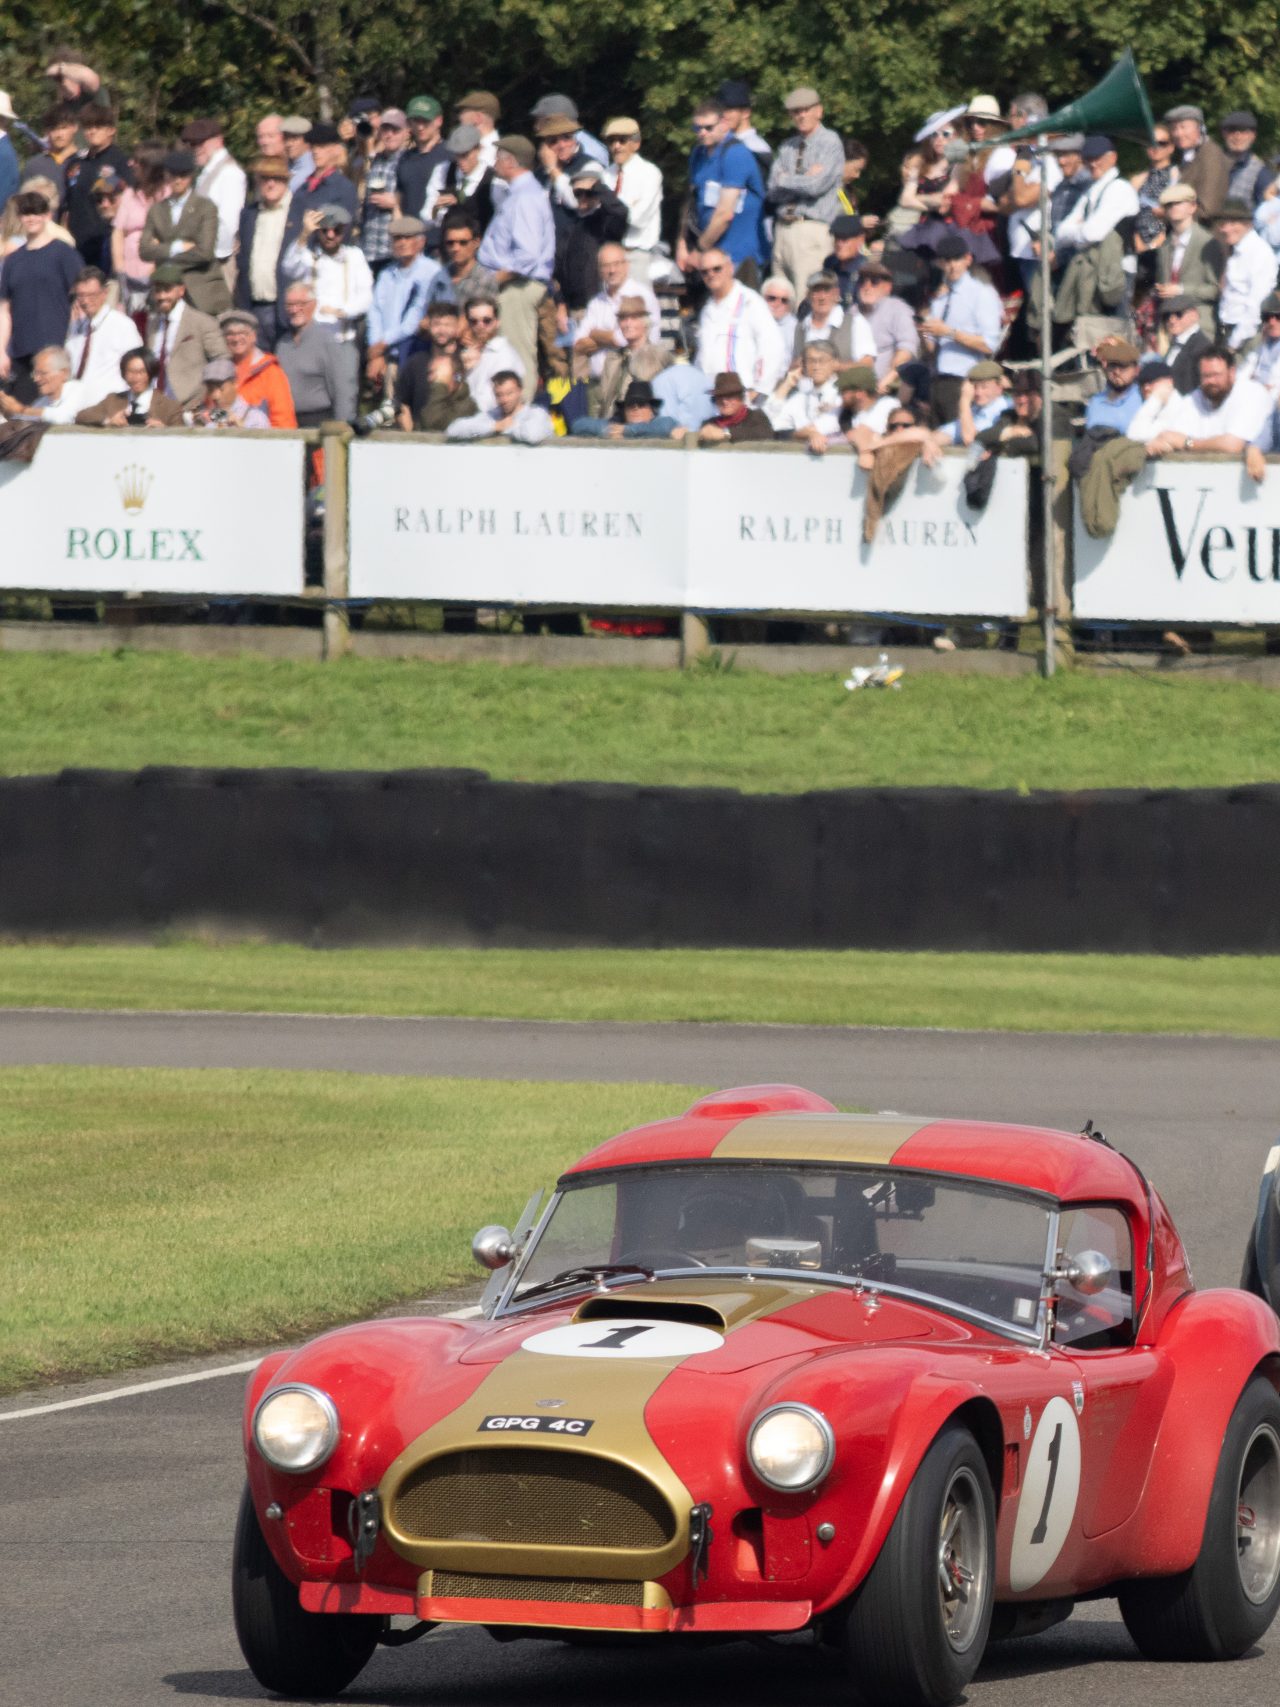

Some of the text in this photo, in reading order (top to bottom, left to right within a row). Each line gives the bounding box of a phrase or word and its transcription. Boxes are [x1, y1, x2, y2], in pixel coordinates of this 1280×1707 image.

[394, 506, 642, 538] RALPH LAUREN
[739, 514, 979, 547] RALPH AUREN
[65, 527, 205, 562] ROLEX
[578, 1325, 656, 1349] 1
[486, 1417, 586, 1433] GPG 4C
[1029, 1422, 1063, 1545] 1
